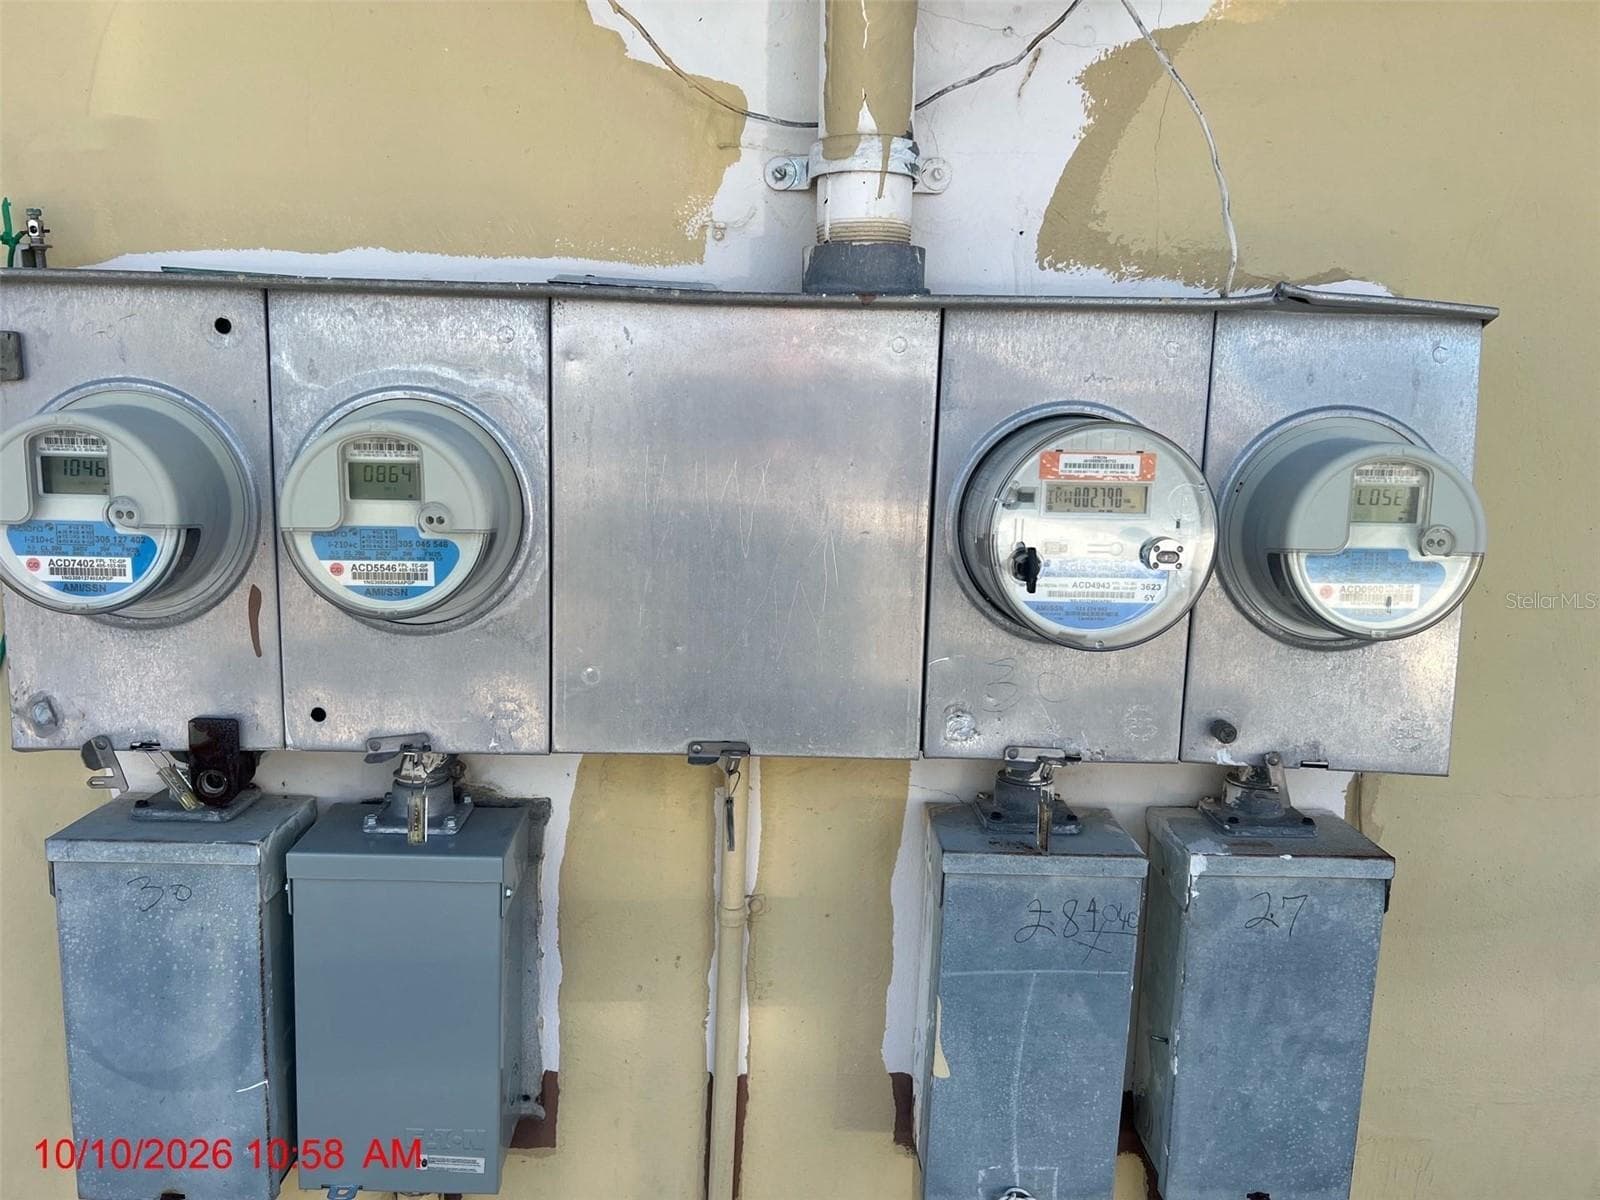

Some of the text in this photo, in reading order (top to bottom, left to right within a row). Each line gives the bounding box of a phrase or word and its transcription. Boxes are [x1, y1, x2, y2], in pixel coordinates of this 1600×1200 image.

[63, 459, 106, 478] 1046
[363, 464, 412, 483] 0864
[48, 558, 95, 568] ACD7402
[351, 563, 397, 572] ACD5546
[1071, 581, 1111, 589] ACD4943
[1140, 583, 1162, 591] 3623
[364, 587, 409, 597] AMI/SSN
[126, 875, 193, 913] 30
